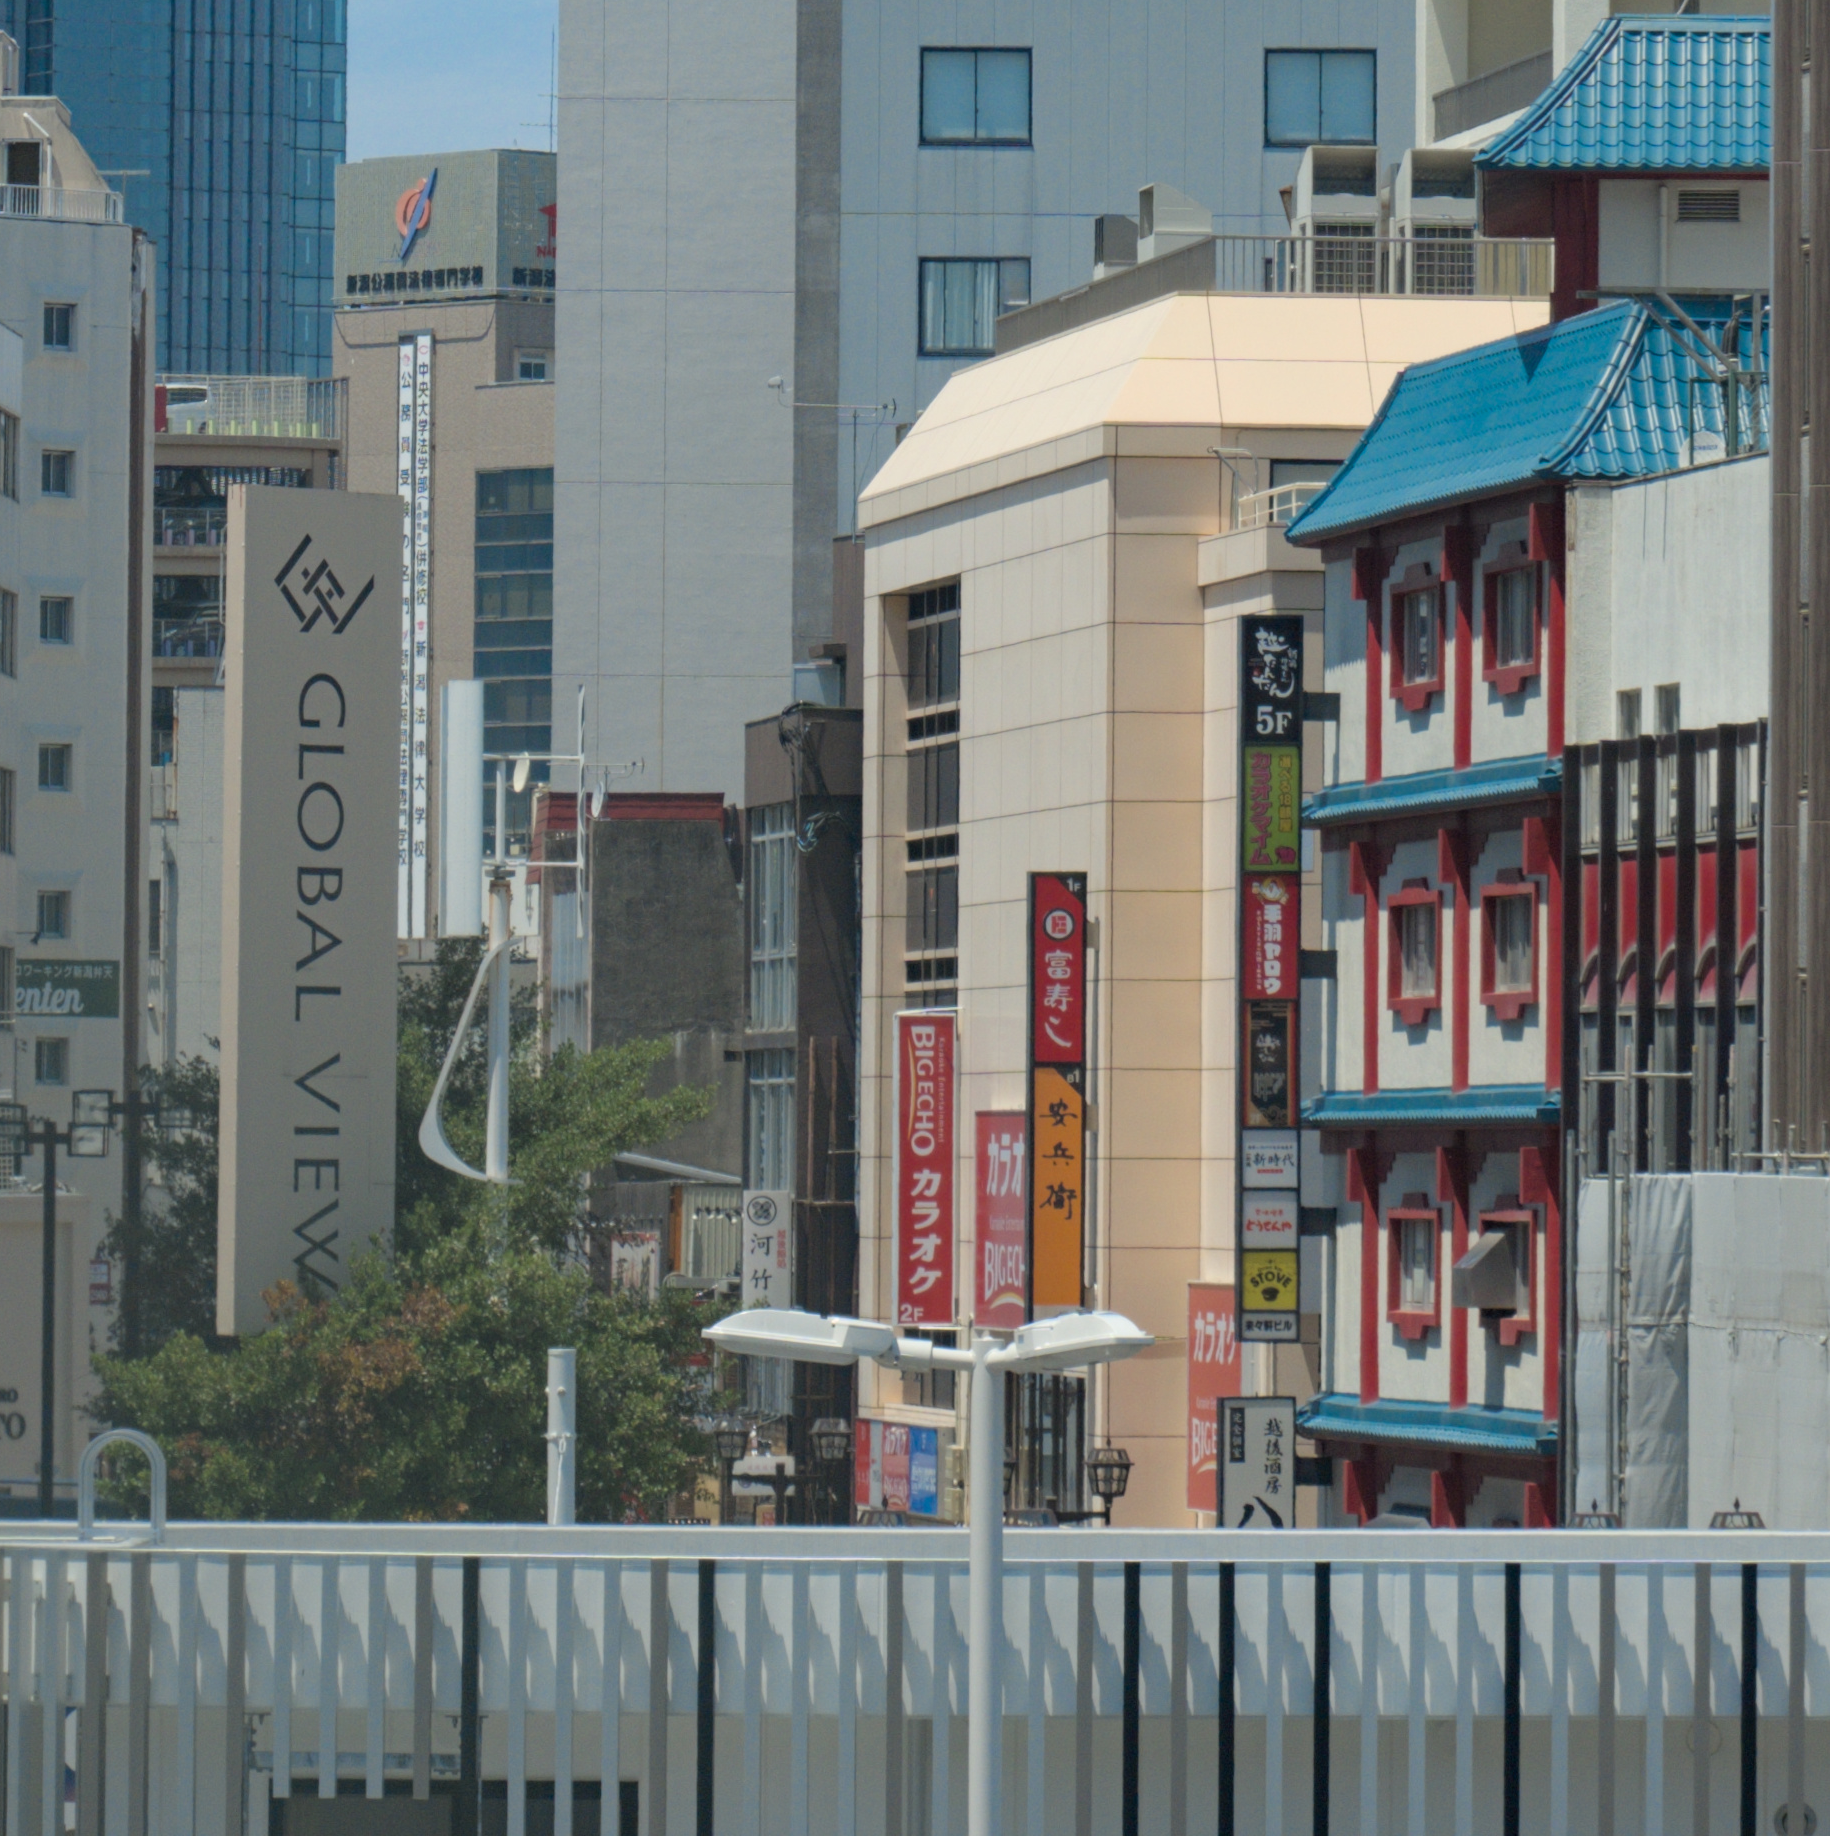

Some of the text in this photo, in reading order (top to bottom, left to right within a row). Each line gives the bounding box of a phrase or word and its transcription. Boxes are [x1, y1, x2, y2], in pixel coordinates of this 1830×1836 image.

[1255, 705, 1293, 735] 5F
[1249, 750, 1274, 866] カラオケマイム
[1066, 877, 1081, 893] 1F
[1263, 904, 1283, 995] 手羽ヤロウ
[291, 672, 347, 1292] GLOBAL VIEW
[910, 1024, 936, 1157] BIG ECHO
[1066, 1068, 1080, 1084] B1
[1039, 1097, 1079, 1221] 安兵衛
[1253, 1151, 1296, 1167] 新時代
[750, 1232, 775, 1291] 河竹
[908, 1168, 943, 1296] カラオケ
[984, 1241, 1006, 1303] BIG
[1249, 1271, 1293, 1288] STOVE
[899, 1303, 925, 1323] 2F
[1192, 1416, 1211, 1468] BIG
